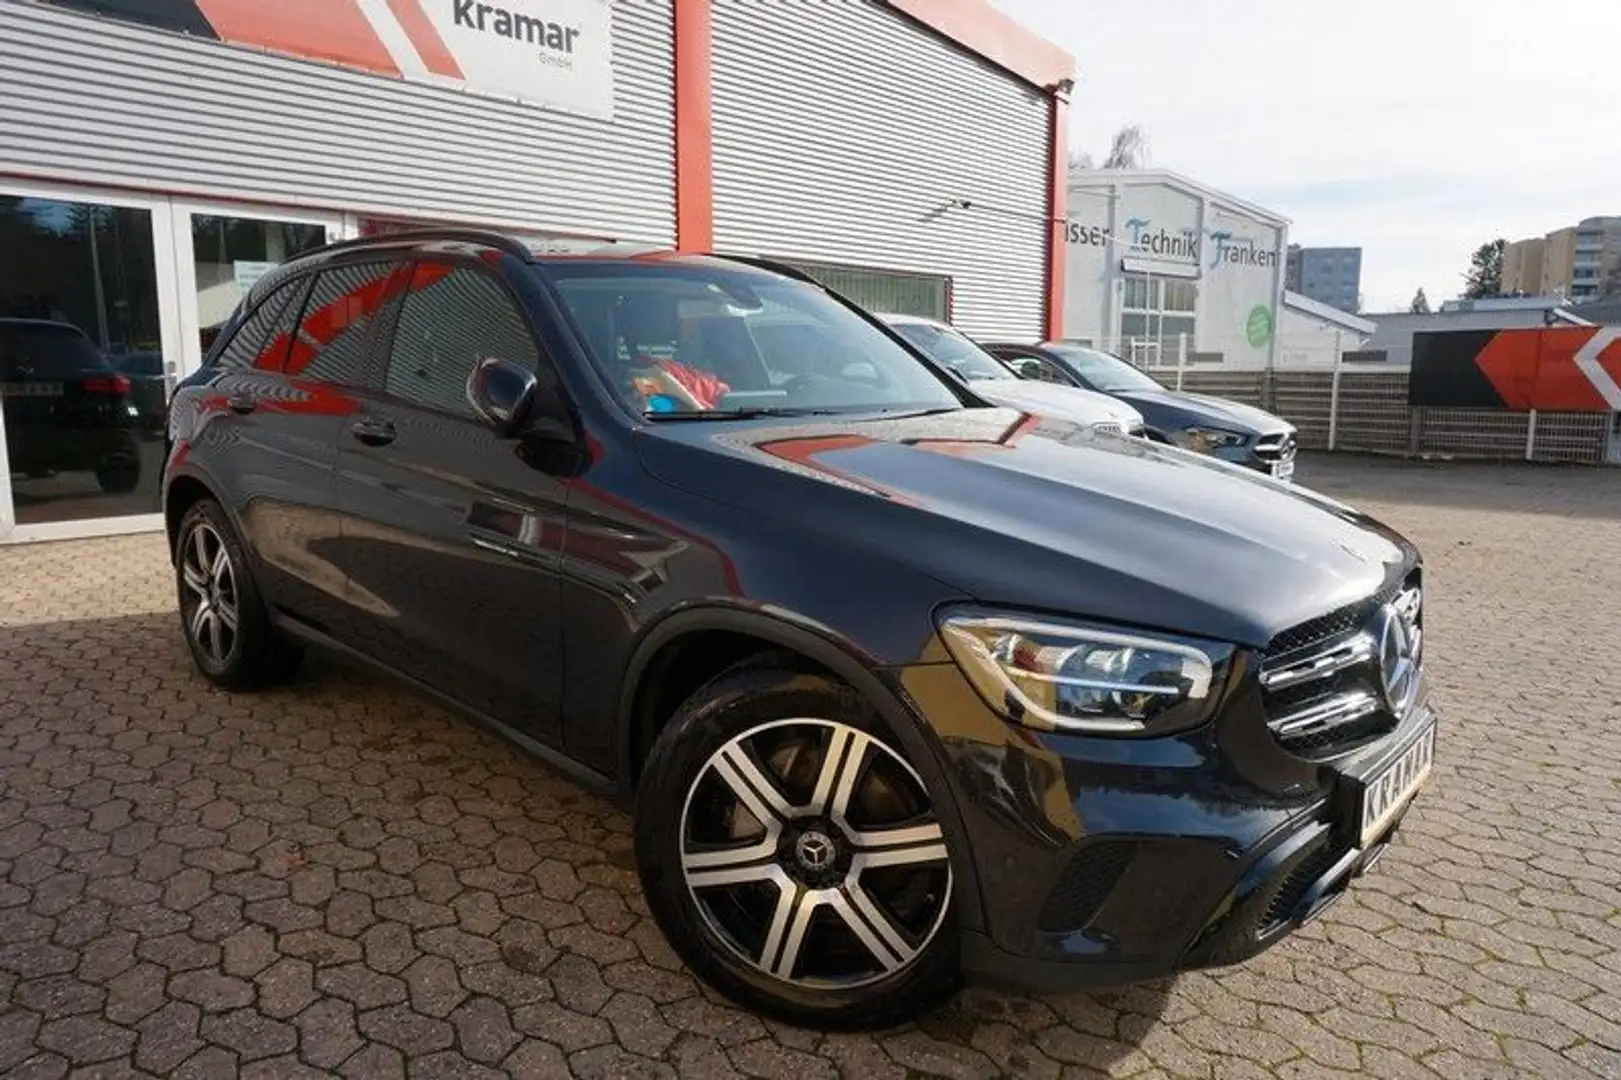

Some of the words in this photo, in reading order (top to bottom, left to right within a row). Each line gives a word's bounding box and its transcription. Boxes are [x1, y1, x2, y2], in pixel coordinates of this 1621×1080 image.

[454, 0, 580, 53] kramar
[1125, 216, 1198, 258] Technik
[1210, 230, 1278, 270] Franken
